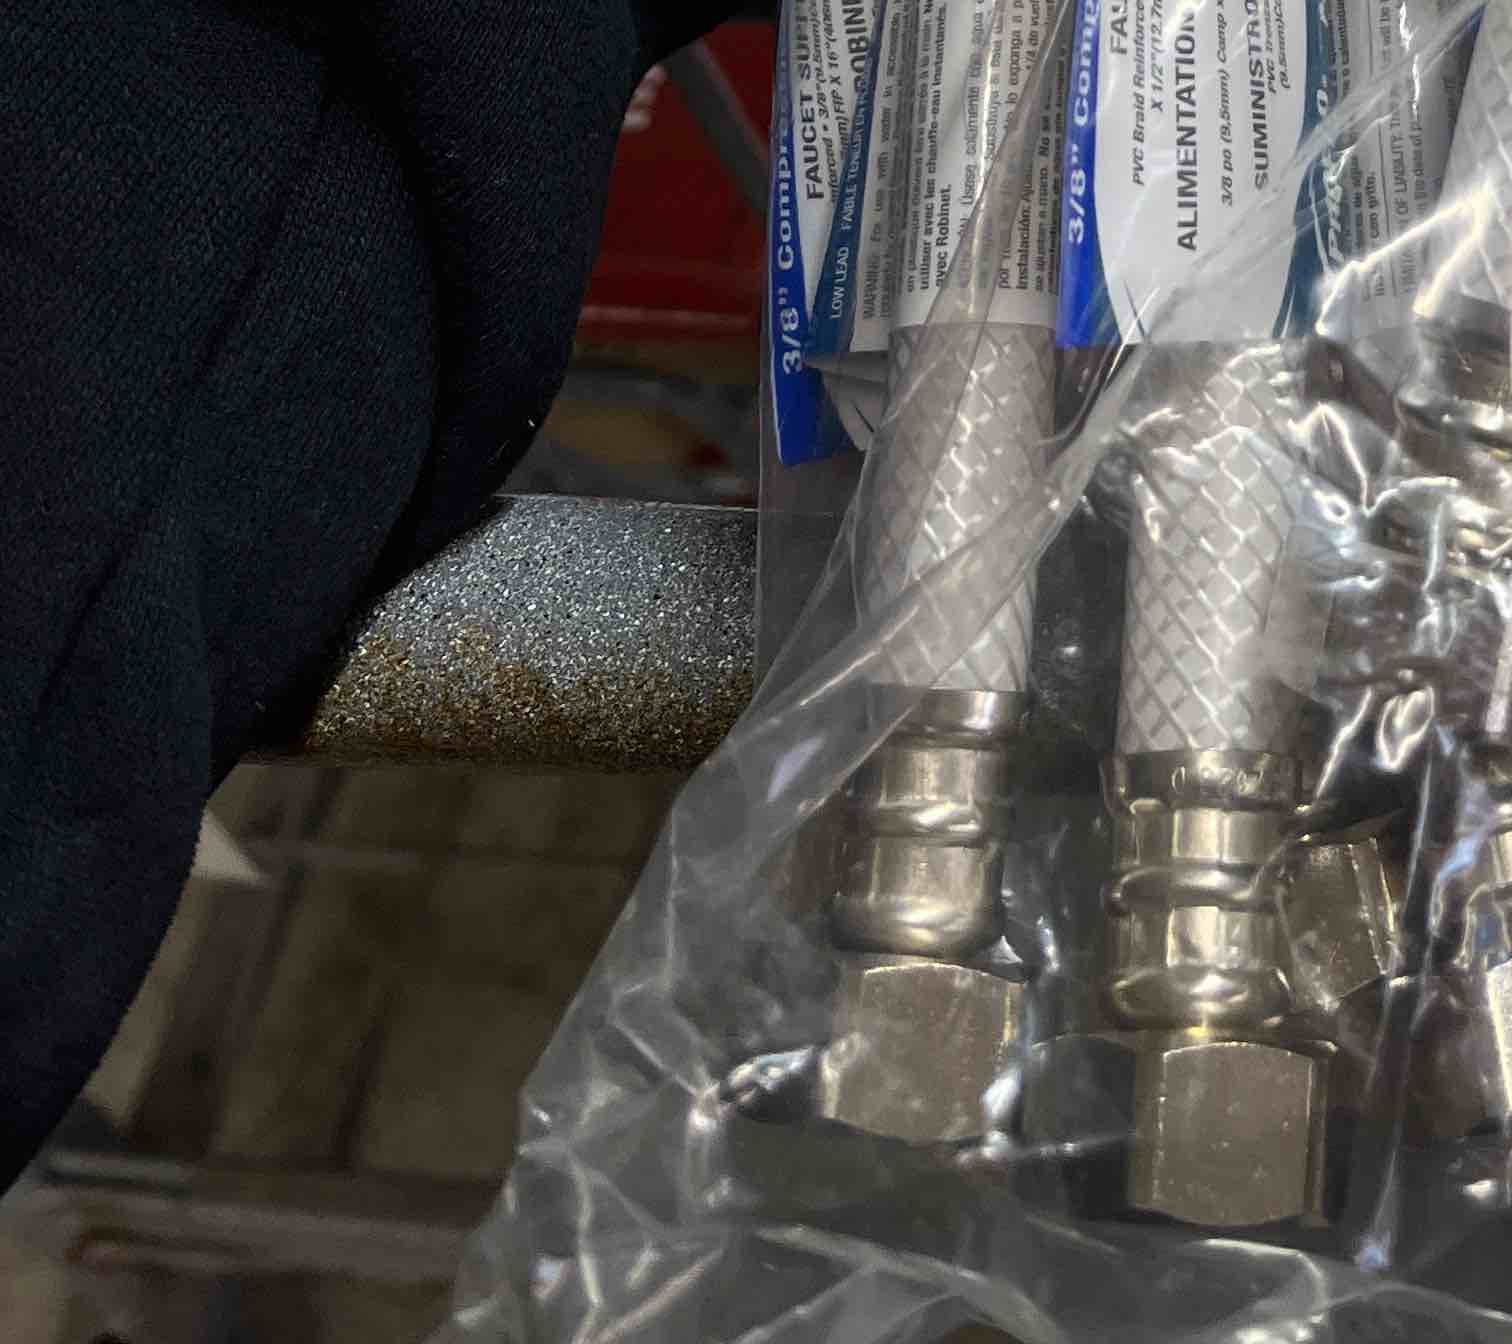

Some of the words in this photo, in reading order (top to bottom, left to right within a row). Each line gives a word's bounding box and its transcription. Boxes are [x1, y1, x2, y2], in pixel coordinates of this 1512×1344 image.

[1216, 13, 1229, 64] Comp
[1264, 58, 1277, 95] PVC
[1132, 93, 1145, 144] Braid
[1150, 101, 1163, 113] X
[799, 88, 825, 200] FAUCET
[1173, 11, 1199, 252] ALIMENTATION
[1132, 147, 1145, 186] PVC
[1221, 149, 1235, 173] po
[1068, 144, 1086, 244] 3/8"
[1220, 175, 1233, 208] 3/8
[924, 202, 937, 236] avec
[832, 247, 850, 282] LEAD
[831, 287, 846, 319] LOW
[779, 287, 801, 374] 3/8"
